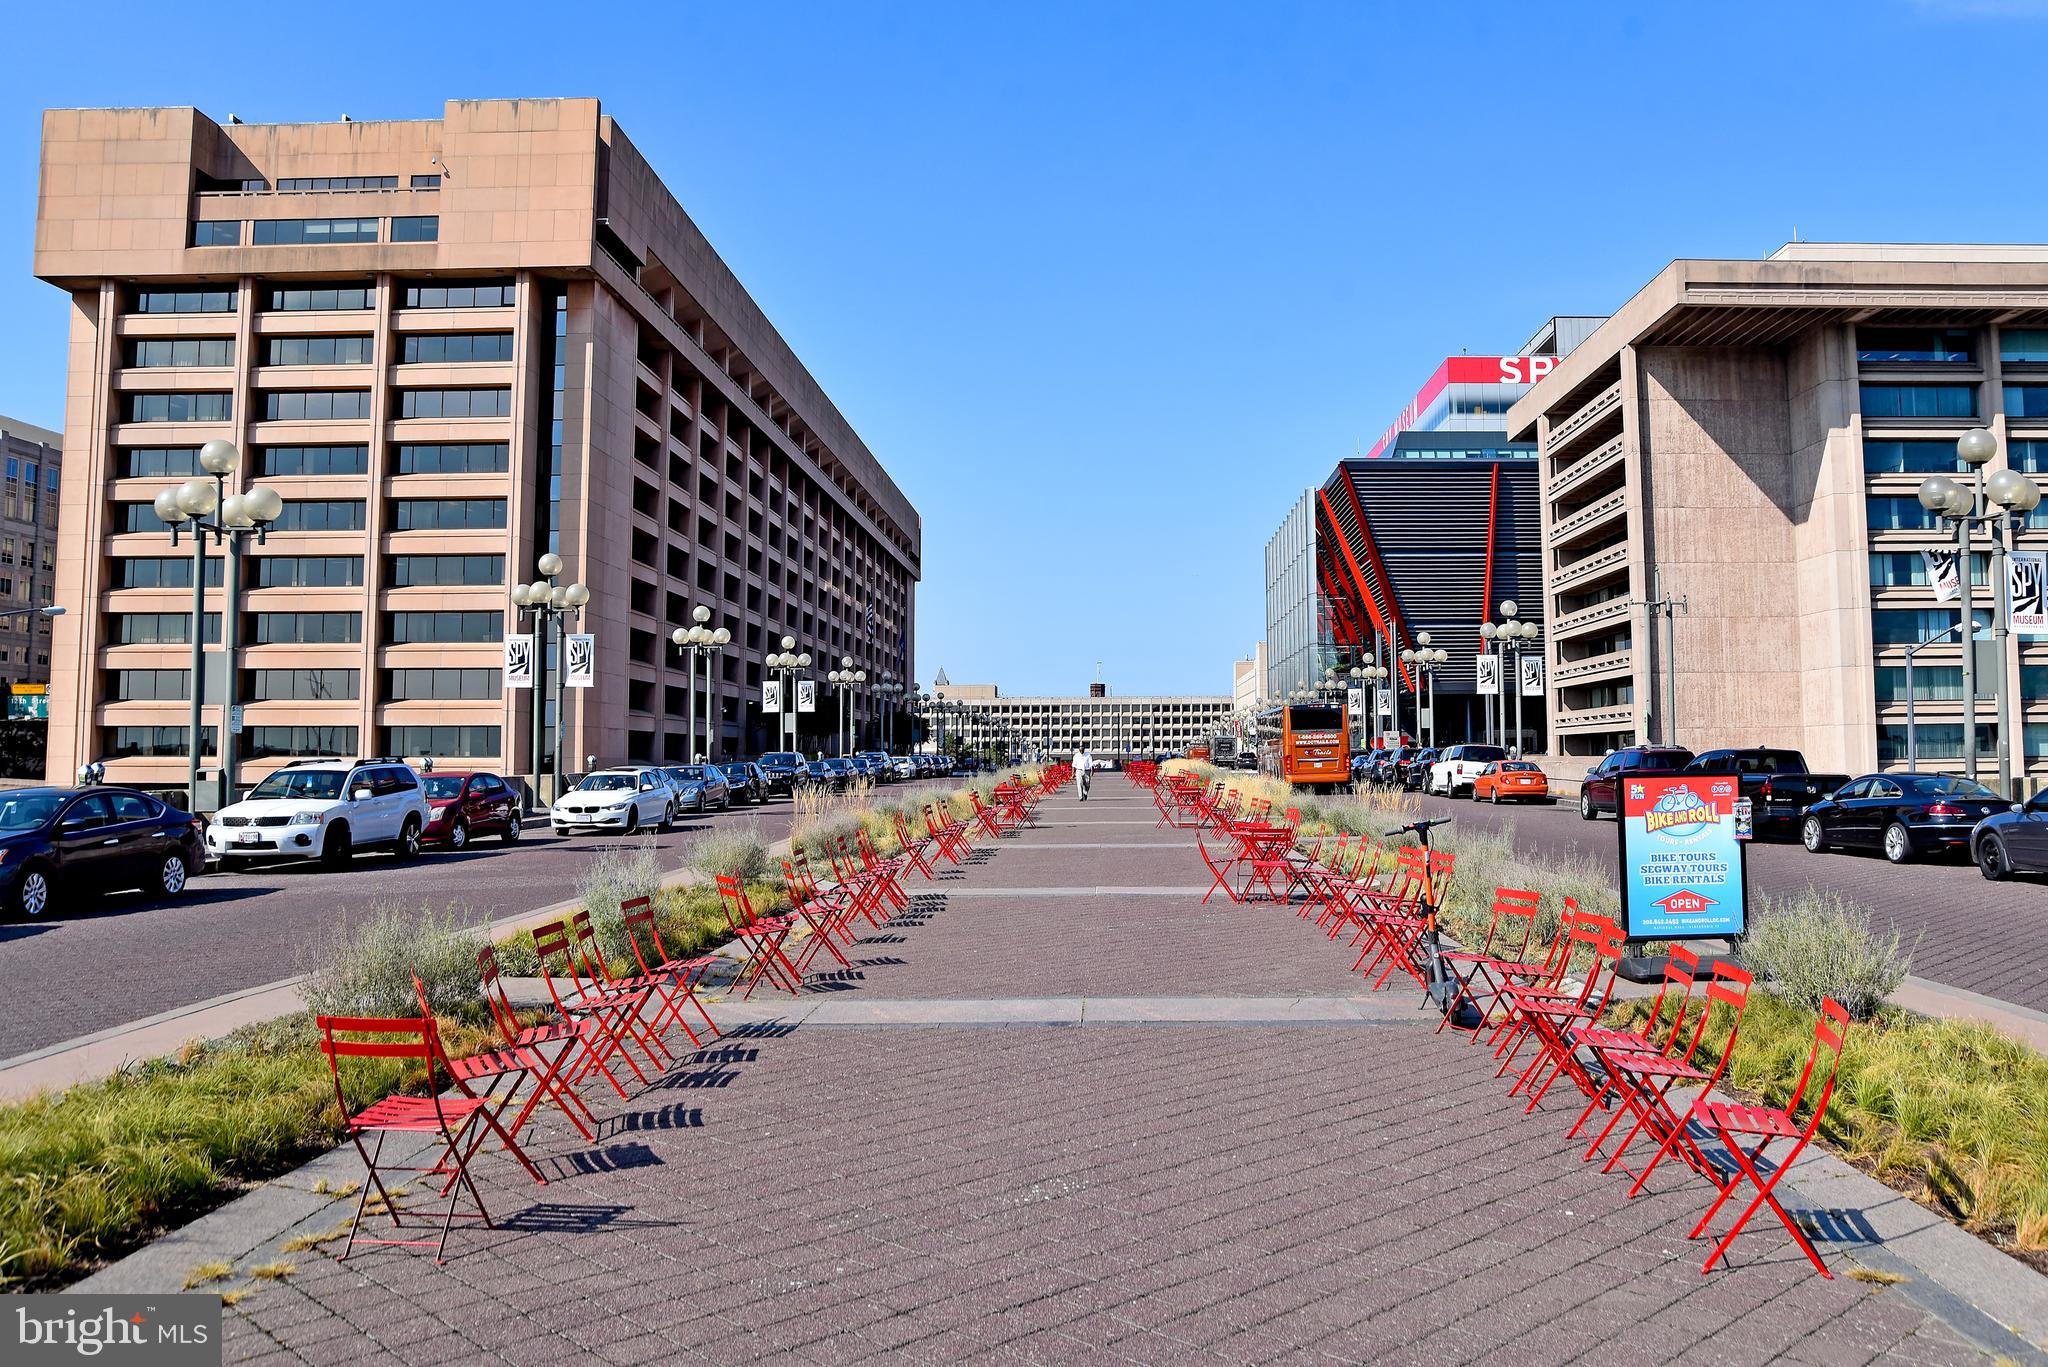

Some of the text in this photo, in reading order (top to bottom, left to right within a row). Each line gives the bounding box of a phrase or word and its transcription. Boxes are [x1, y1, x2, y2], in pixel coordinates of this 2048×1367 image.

[1499, 356, 1565, 384] SP
[1939, 576, 1960, 592] MUSE
[2012, 562, 2042, 598] SPY
[2013, 615, 2044, 625] MUSEUM
[509, 642, 530, 664] SPY
[570, 641, 591, 664] SPY
[1480, 660, 1496, 677] SPY
[1525, 662, 1540, 678] SPY
[1630, 784, 1638, 793] 5
[1645, 810, 1674, 833] BIKE
[1674, 811, 1688, 823] AND
[1688, 801, 1720, 824] ROLL
[1657, 828, 1712, 846] TOURS RENTALS
[1650, 853, 1716, 862] BIKE TOURS
[1640, 863, 1728, 874] SEGWAY TOURS
[1644, 874, 1725, 885] BIKE RENTALS
[1670, 898, 1700, 909] OPEN
